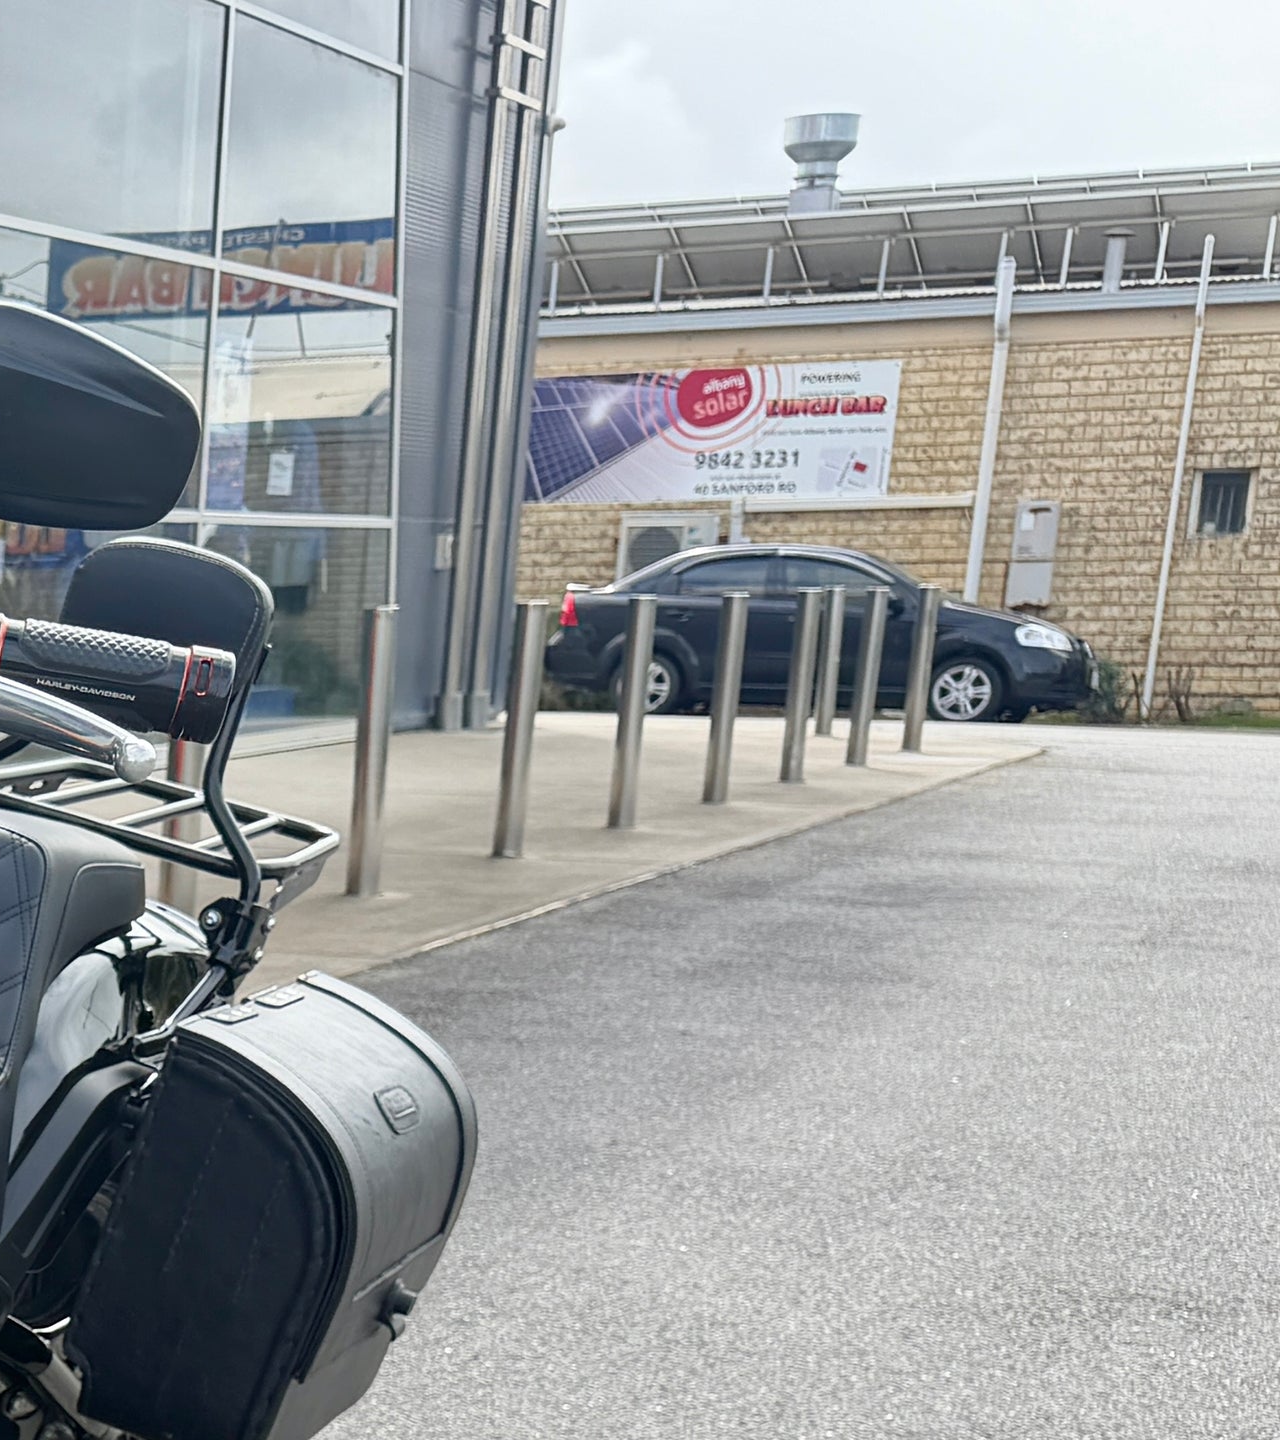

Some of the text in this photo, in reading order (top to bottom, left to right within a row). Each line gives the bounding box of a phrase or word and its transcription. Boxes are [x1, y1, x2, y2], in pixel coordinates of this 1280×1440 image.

[703, 374, 746, 395] albany
[801, 372, 862, 384] POWERING
[692, 391, 751, 421] solar
[766, 397, 839, 418] LUNCH
[694, 448, 801, 470] 9842 3231
[36, 677, 136, 702] HARLEY-DAVIDSON
